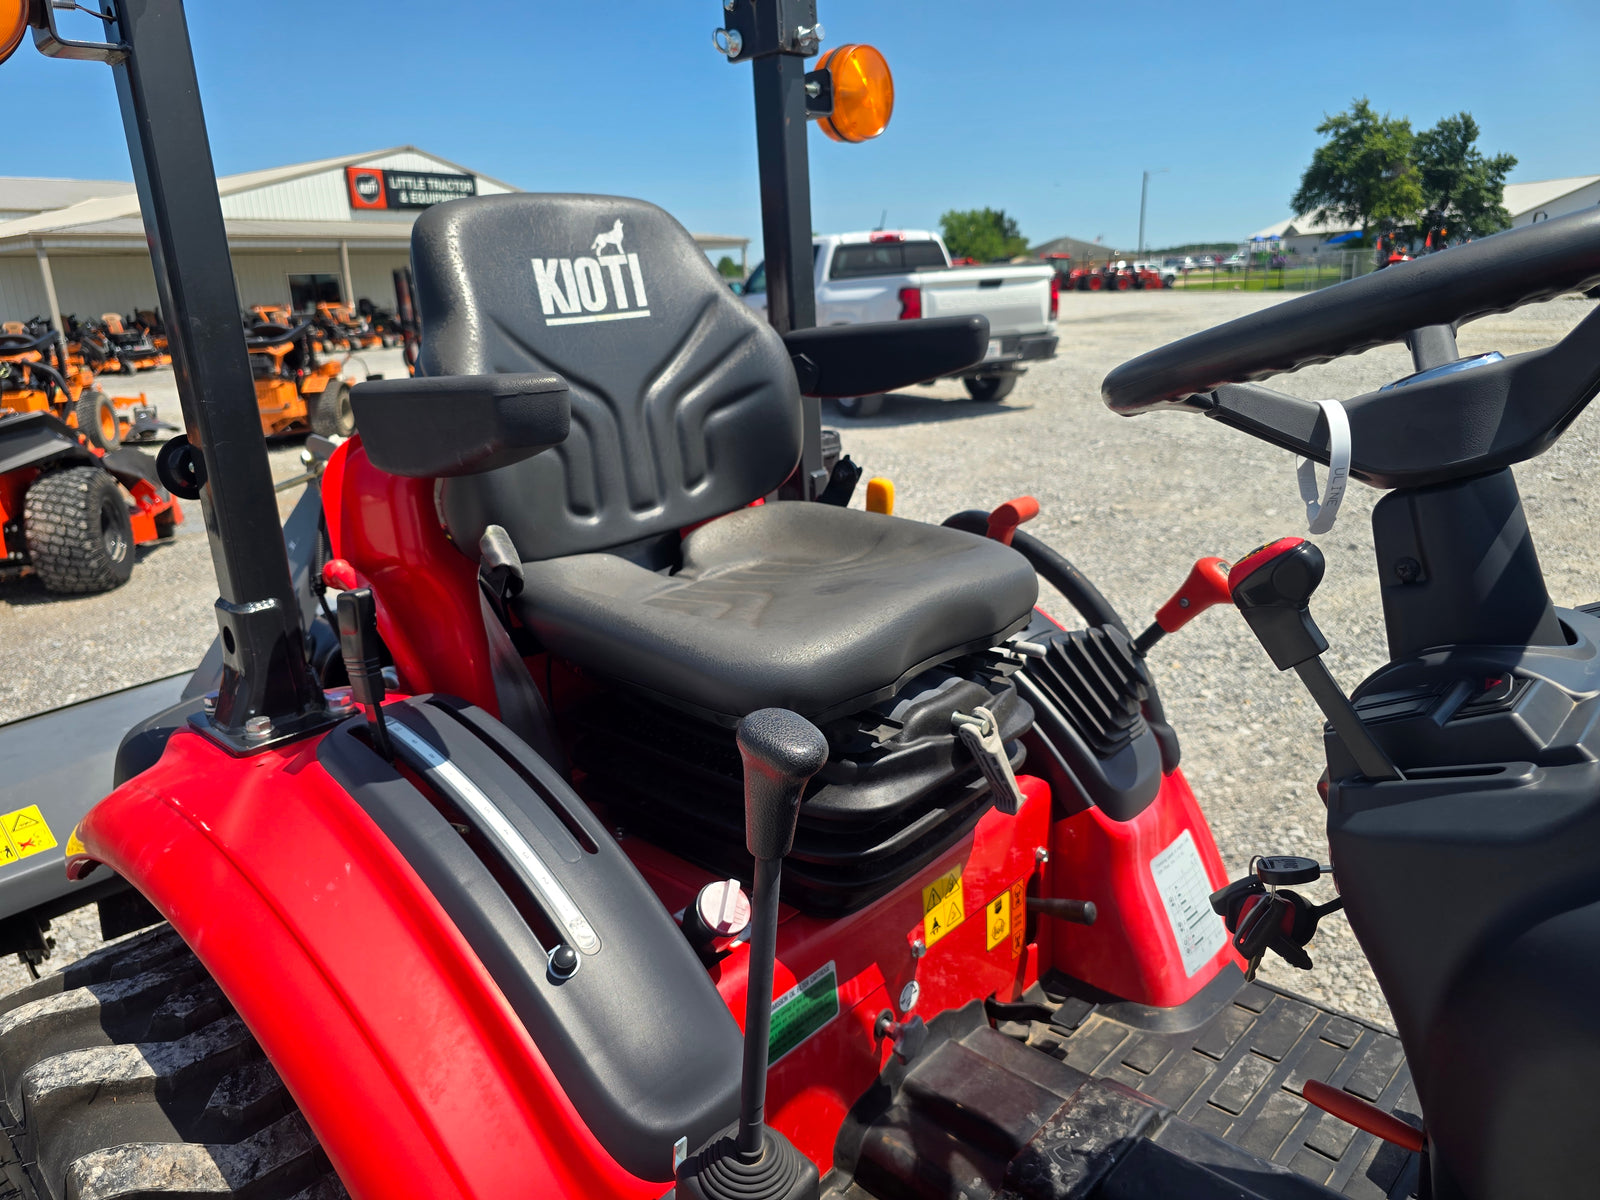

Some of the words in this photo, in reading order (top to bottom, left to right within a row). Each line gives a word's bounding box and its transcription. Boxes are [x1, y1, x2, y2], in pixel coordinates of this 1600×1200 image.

[388, 175, 427, 191] LITTLE
[428, 177, 474, 194] TRACTOR
[399, 190, 409, 203] &
[531, 253, 648, 315] KIOTI
[1327, 467, 1346, 507] ULINE
